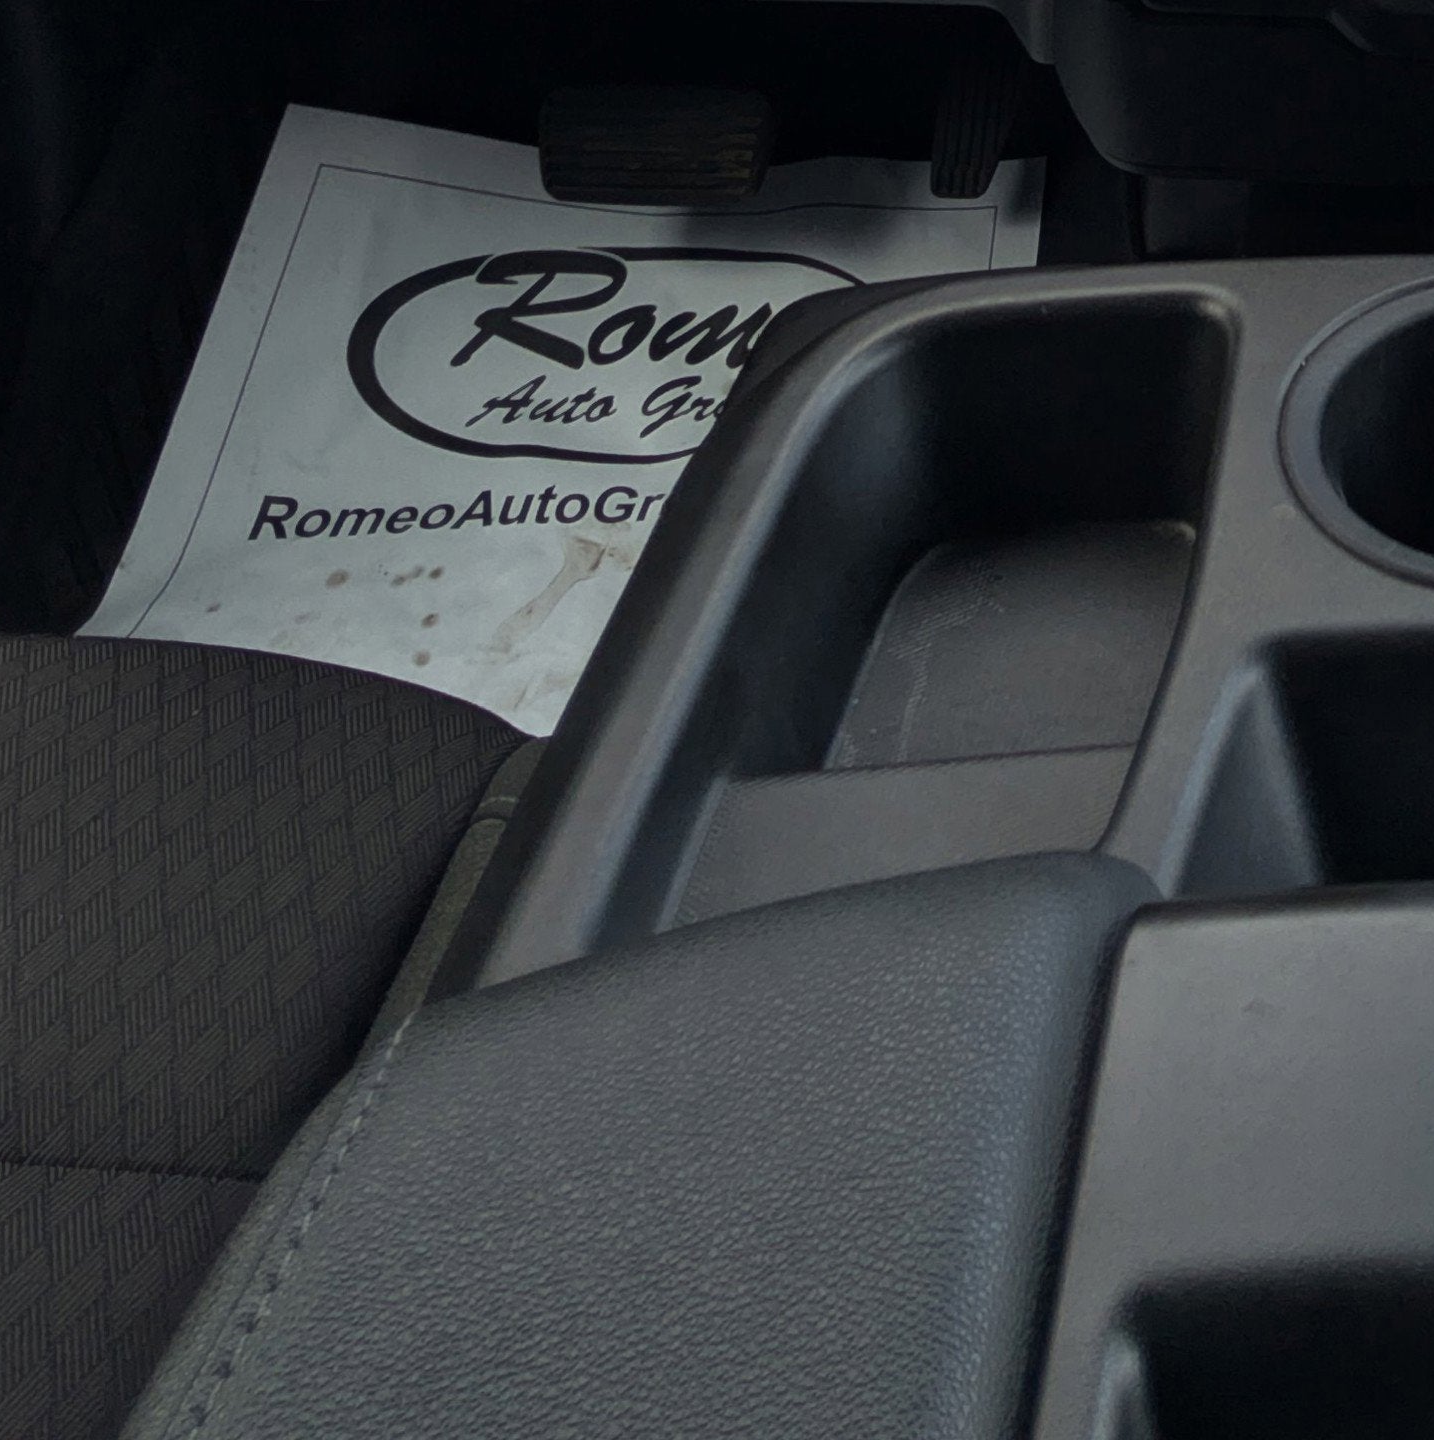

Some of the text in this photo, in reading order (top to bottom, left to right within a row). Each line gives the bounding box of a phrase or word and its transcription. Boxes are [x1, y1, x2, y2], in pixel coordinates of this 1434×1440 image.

[450, 249, 773, 370] Rom
[465, 375, 617, 429] Auto
[248, 485, 667, 541] RomeoAutoGr
